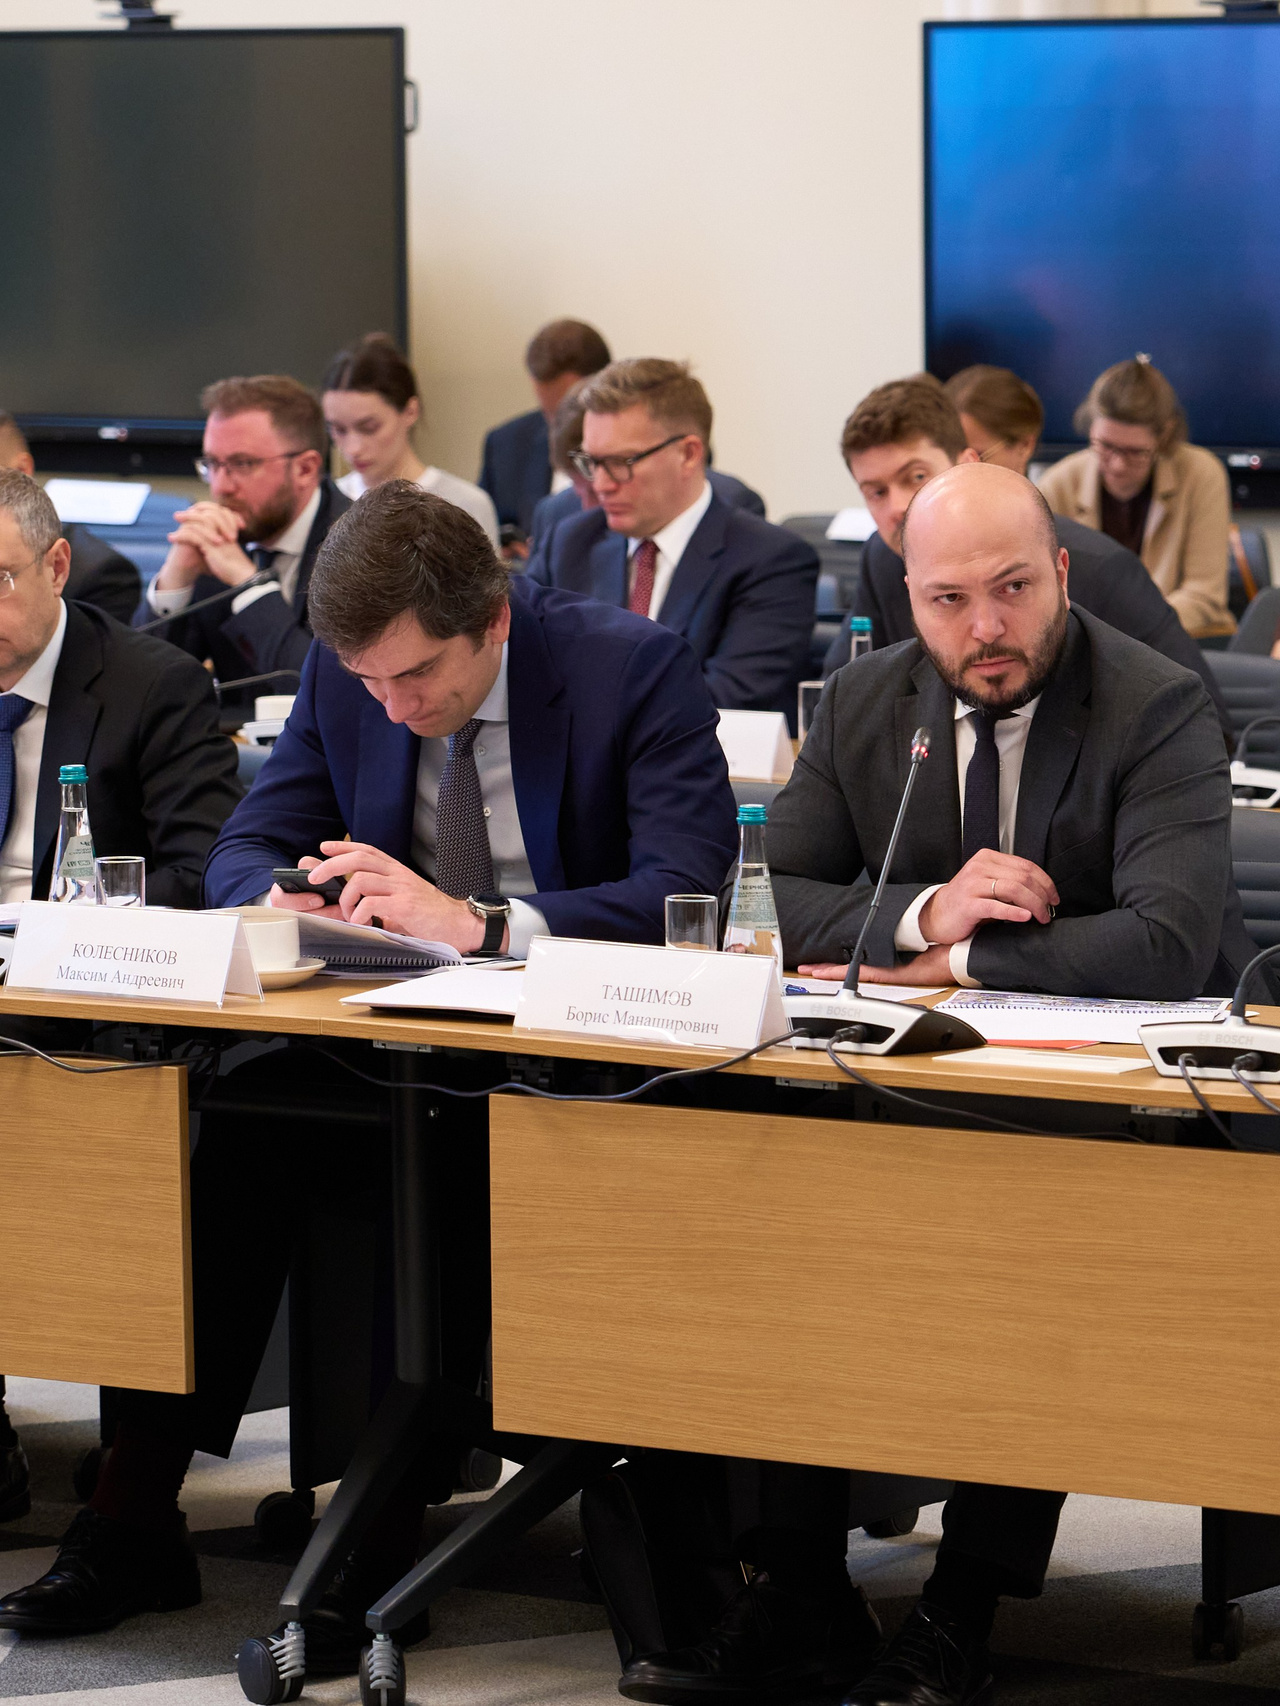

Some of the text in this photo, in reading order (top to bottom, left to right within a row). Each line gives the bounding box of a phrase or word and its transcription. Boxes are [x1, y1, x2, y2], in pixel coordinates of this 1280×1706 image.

[72, 943, 178, 965] КОЛЕСНИКОВ
[56, 965, 185, 989] Максим Андреевич
[602, 984, 693, 1007] ТАШИМОВ
[565, 1005, 719, 1035] Борис Манаширович
[826, 1005, 862, 1018] BOSCH
[1215, 1033, 1254, 1046] BOSCH
